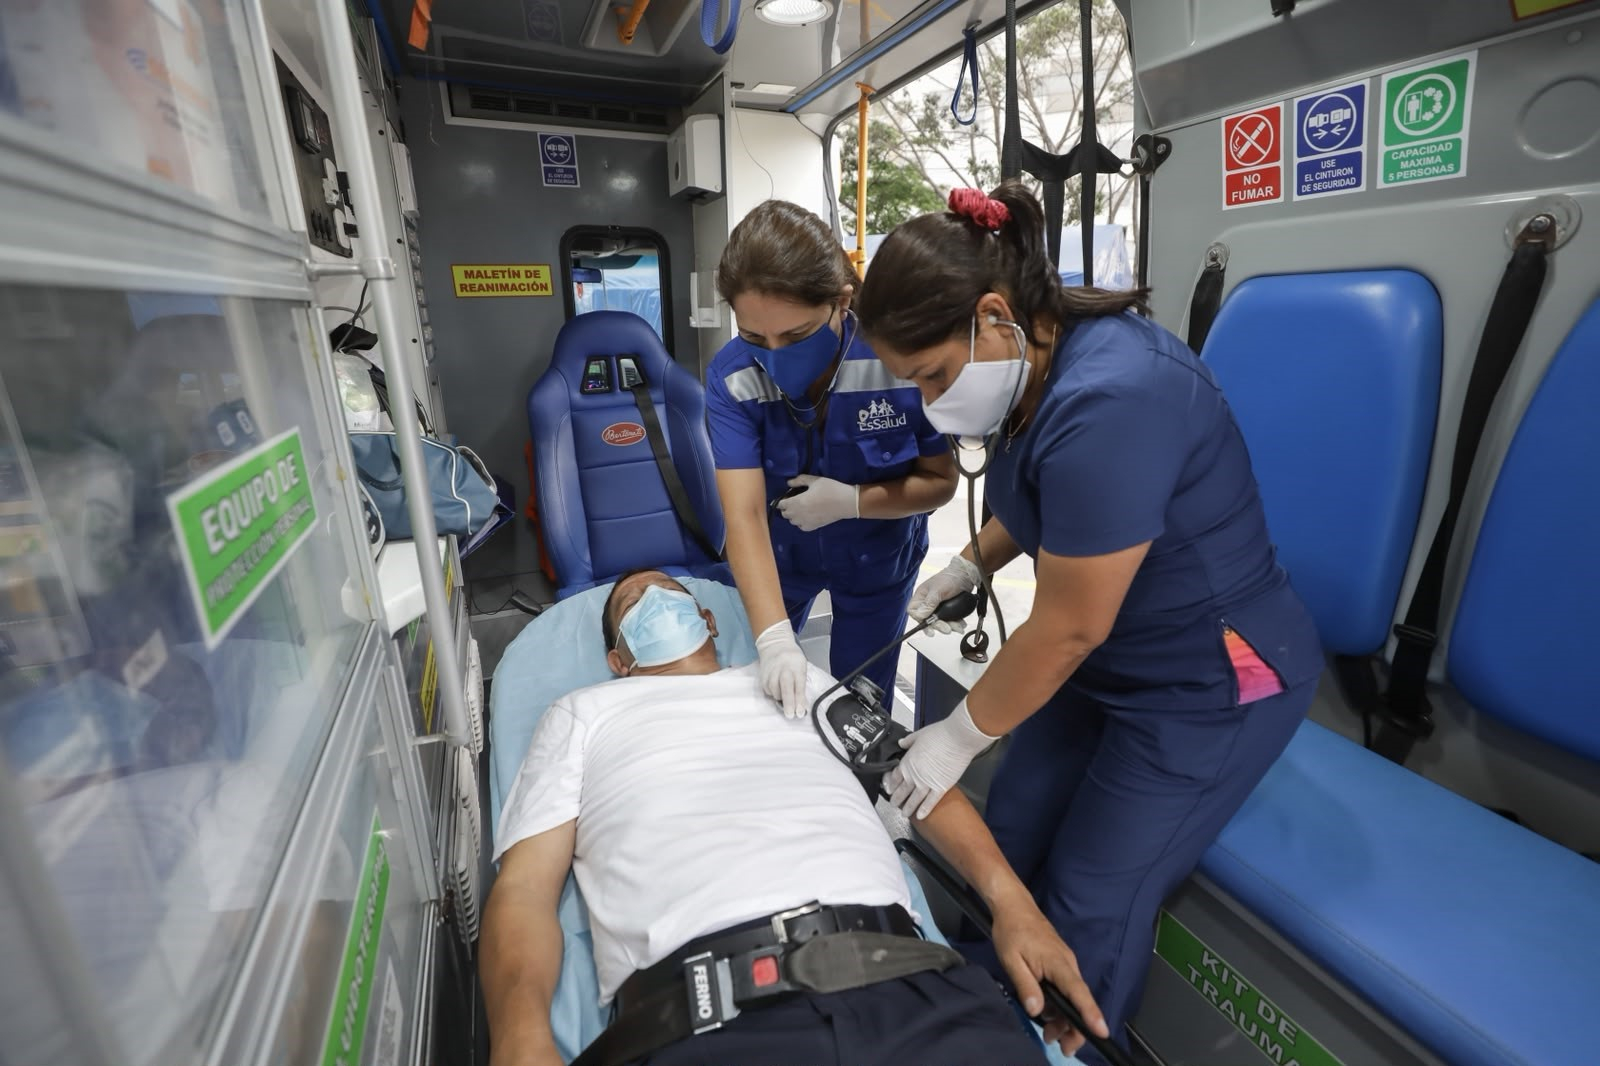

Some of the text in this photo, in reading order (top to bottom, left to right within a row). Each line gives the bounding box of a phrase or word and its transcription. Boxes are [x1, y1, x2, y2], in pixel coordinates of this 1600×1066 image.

[1391, 142, 1453, 160] CAPACIDAD
[1320, 159, 1337, 169] USE
[1400, 155, 1442, 169] MAXIMA
[1243, 173, 1261, 187] NO
[1304, 166, 1354, 183] EL CINTURON
[1388, 163, 1454, 181] 5 PERSONAS
[1301, 176, 1356, 193] DE SEGURIDAD
[1231, 186, 1274, 203] FUMAR
[464, 267, 541, 279] MALETÍN DE
[459, 281, 549, 293] REANIMACIÓN
[201, 452, 300, 554] EQUIPO DE
[693, 965, 713, 1019] FERNO
[1202, 950, 1298, 1046] KIT DE
